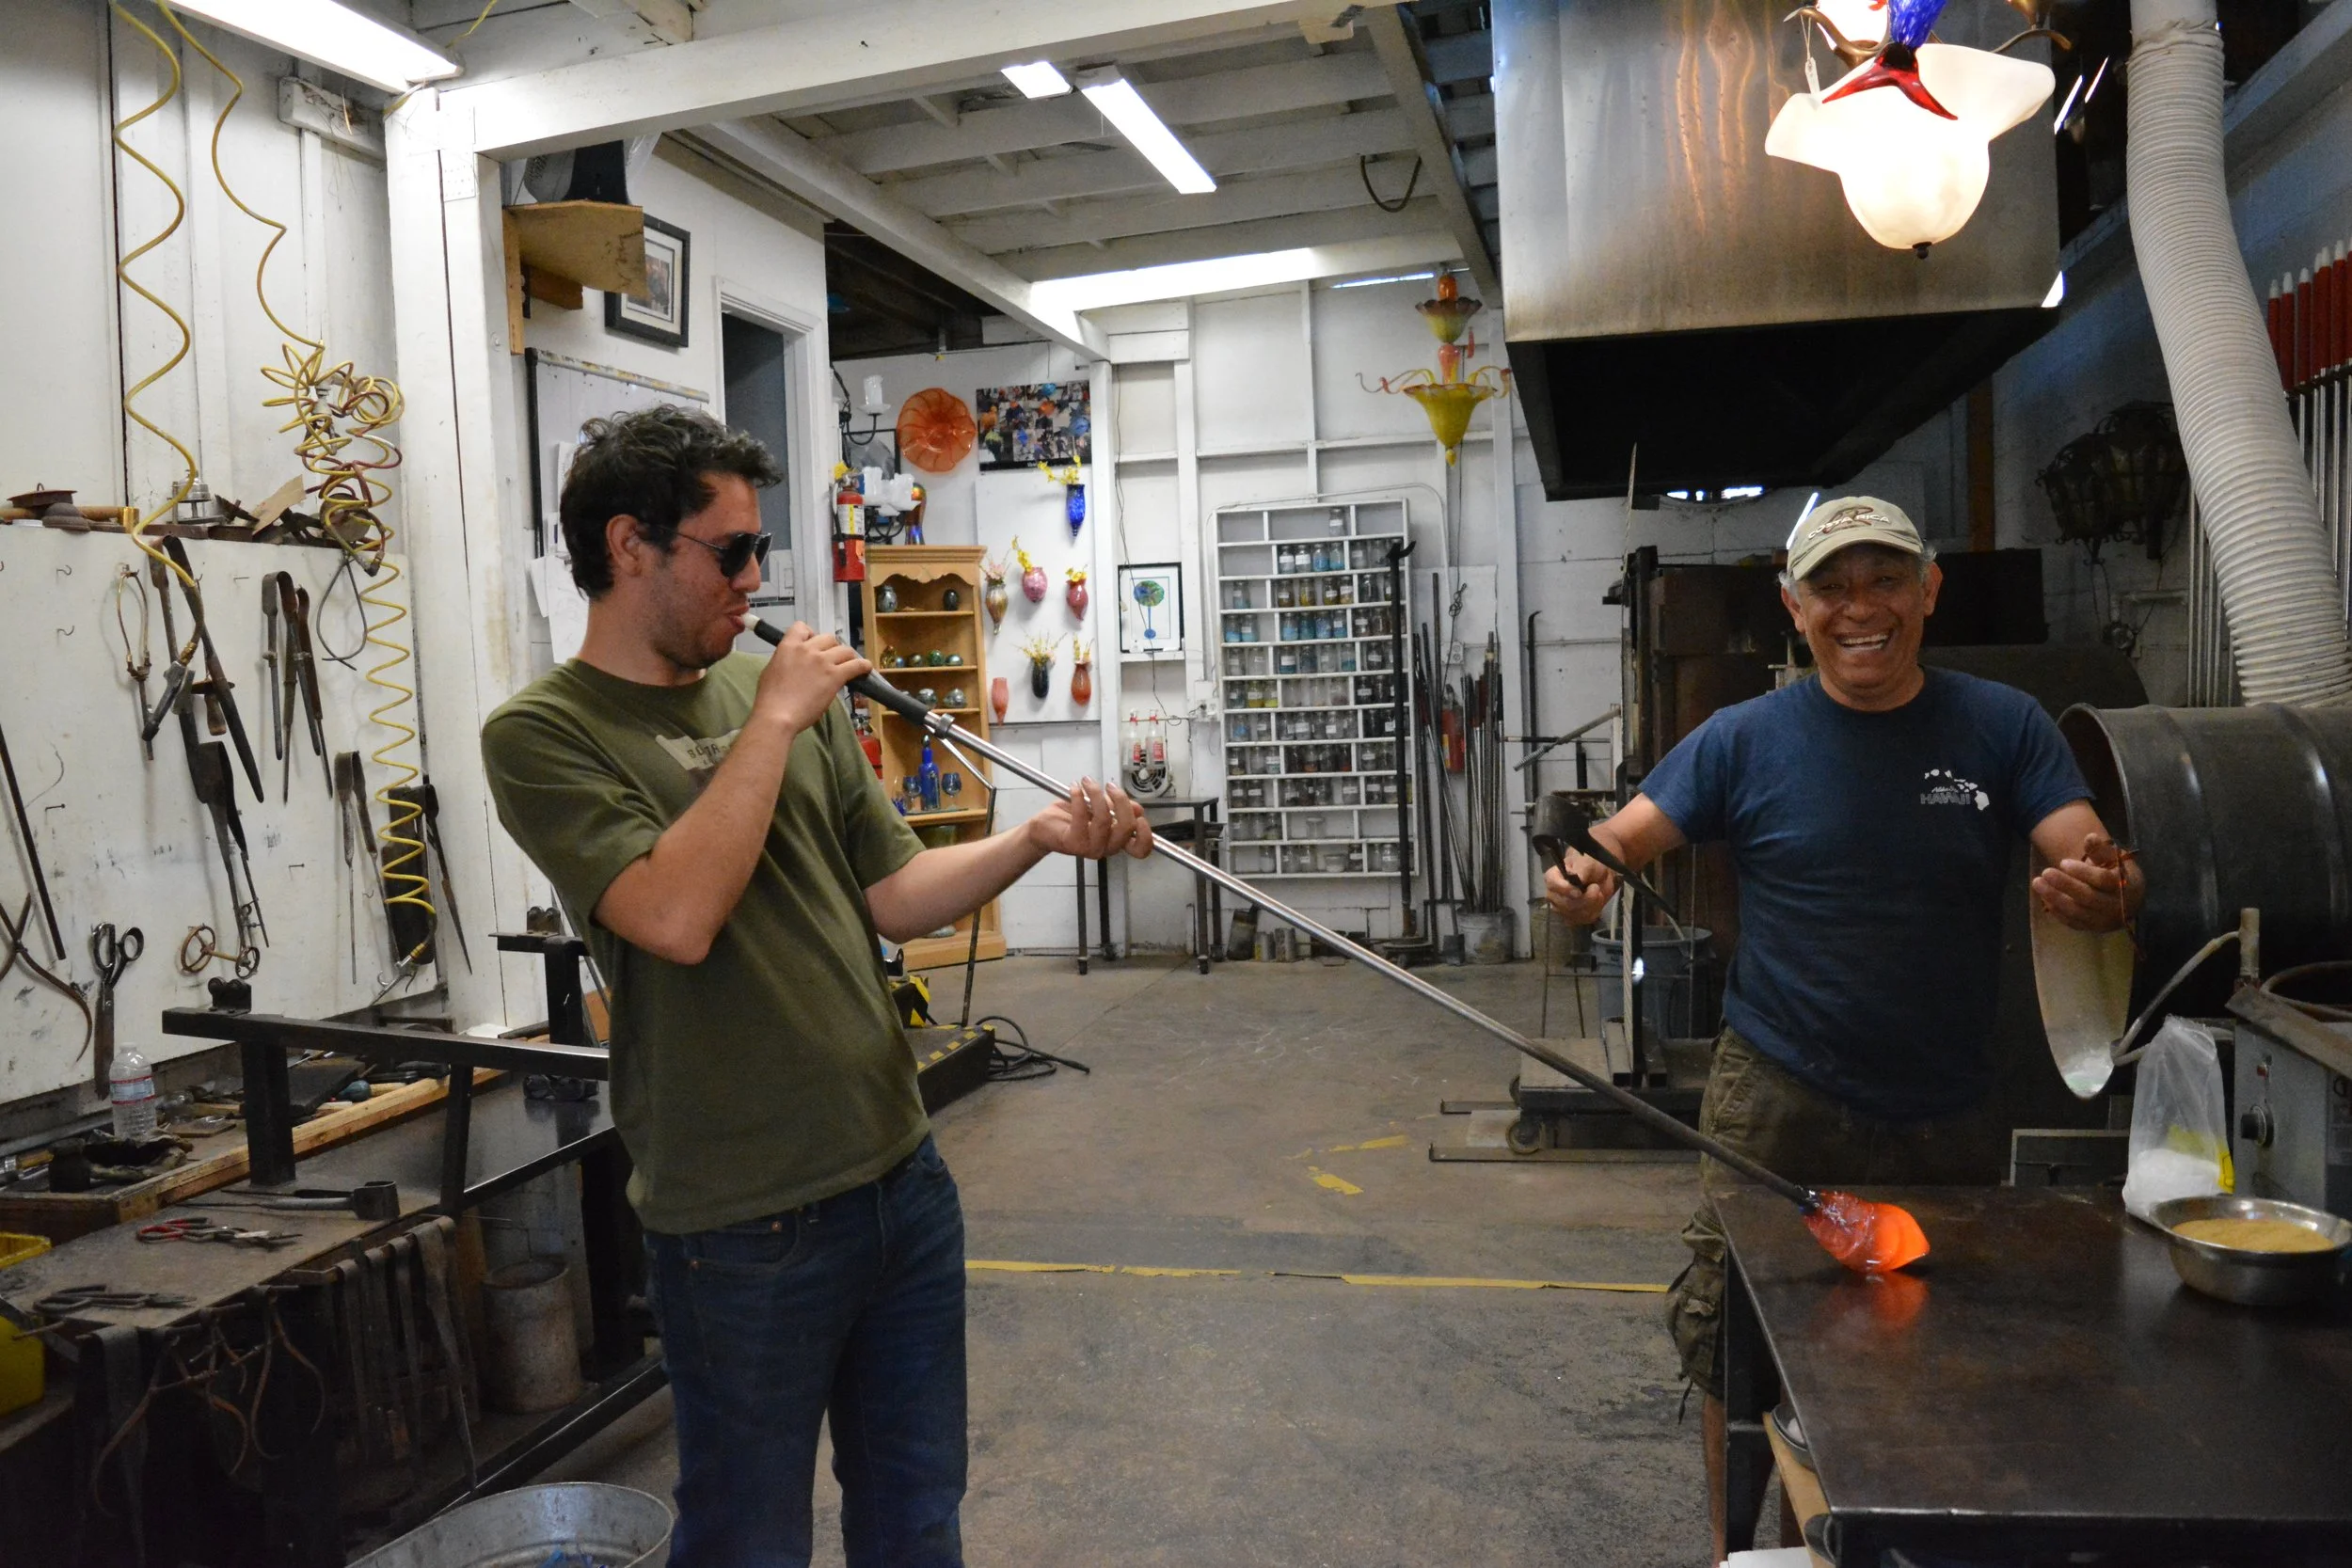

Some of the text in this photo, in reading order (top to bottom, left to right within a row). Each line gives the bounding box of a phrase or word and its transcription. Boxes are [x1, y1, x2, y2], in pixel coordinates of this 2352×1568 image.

[1808, 514, 1890, 539] COSTA RICA
[1920, 793, 1971, 804] HAWAII
